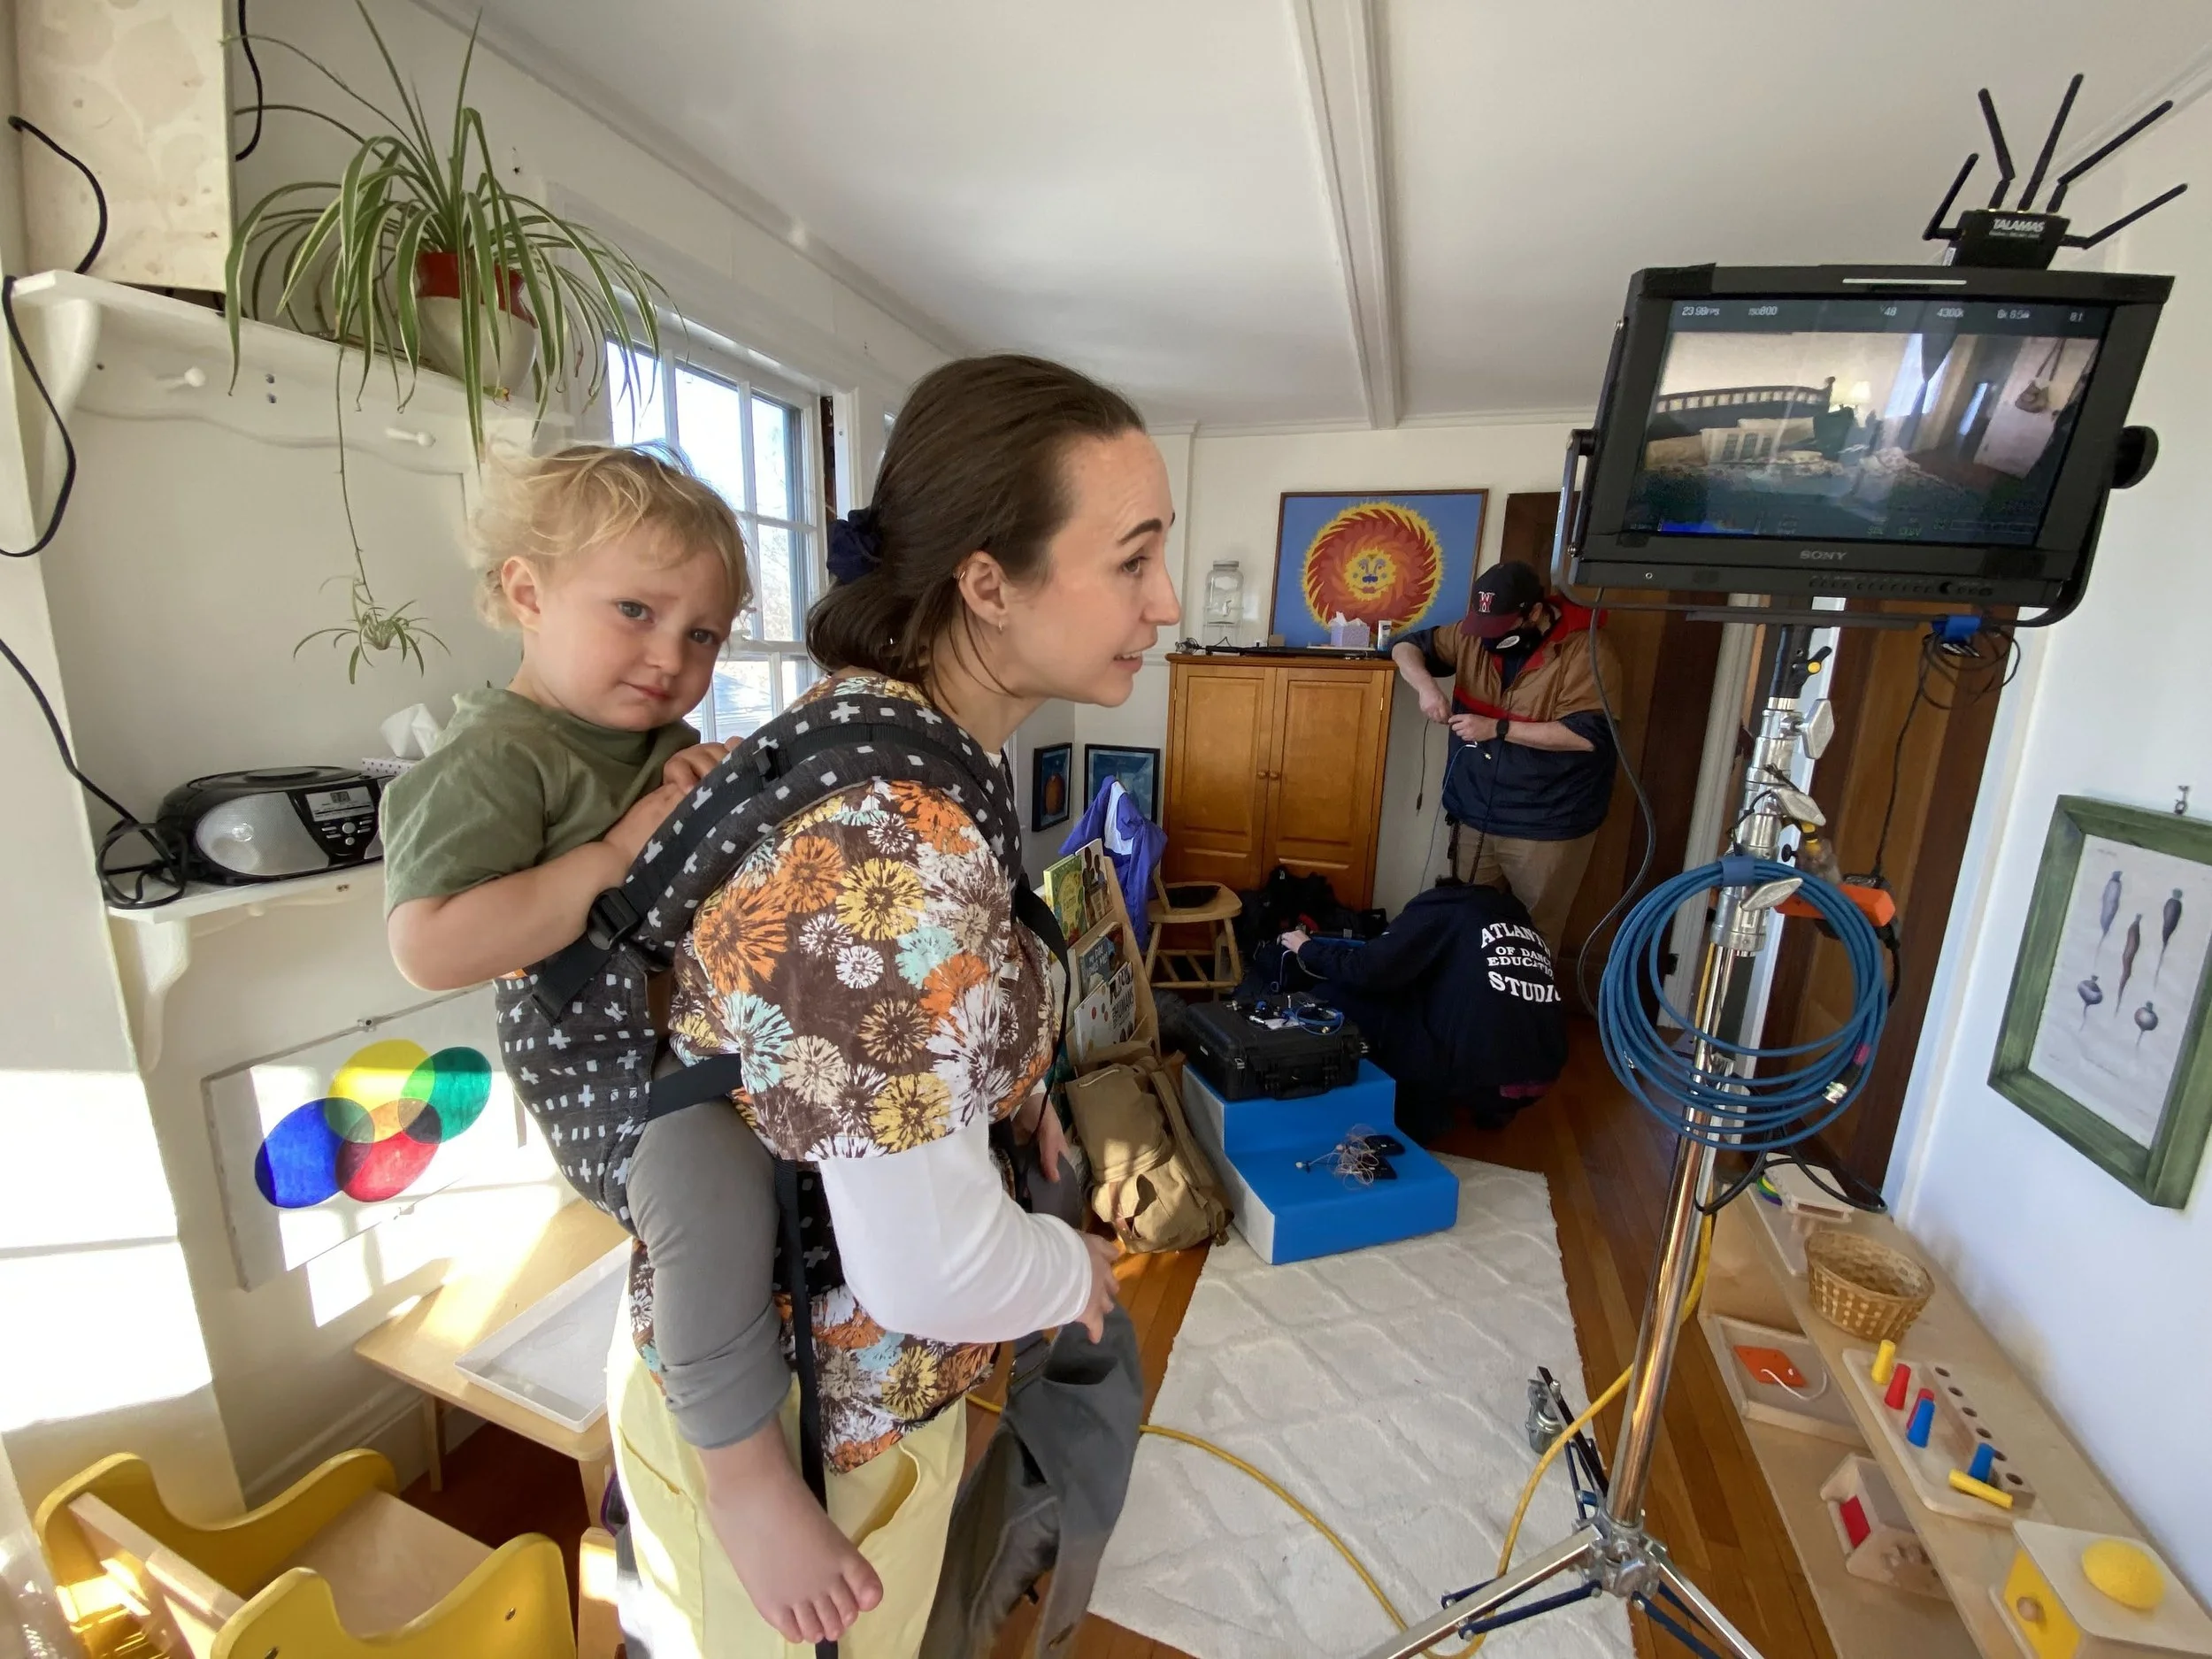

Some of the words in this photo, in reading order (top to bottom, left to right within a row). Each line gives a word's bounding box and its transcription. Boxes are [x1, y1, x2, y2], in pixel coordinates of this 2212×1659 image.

[1993, 219, 2046, 233] TALAMAS
[1799, 550, 1847, 561] SONY
[1495, 946, 1516, 956] OF
